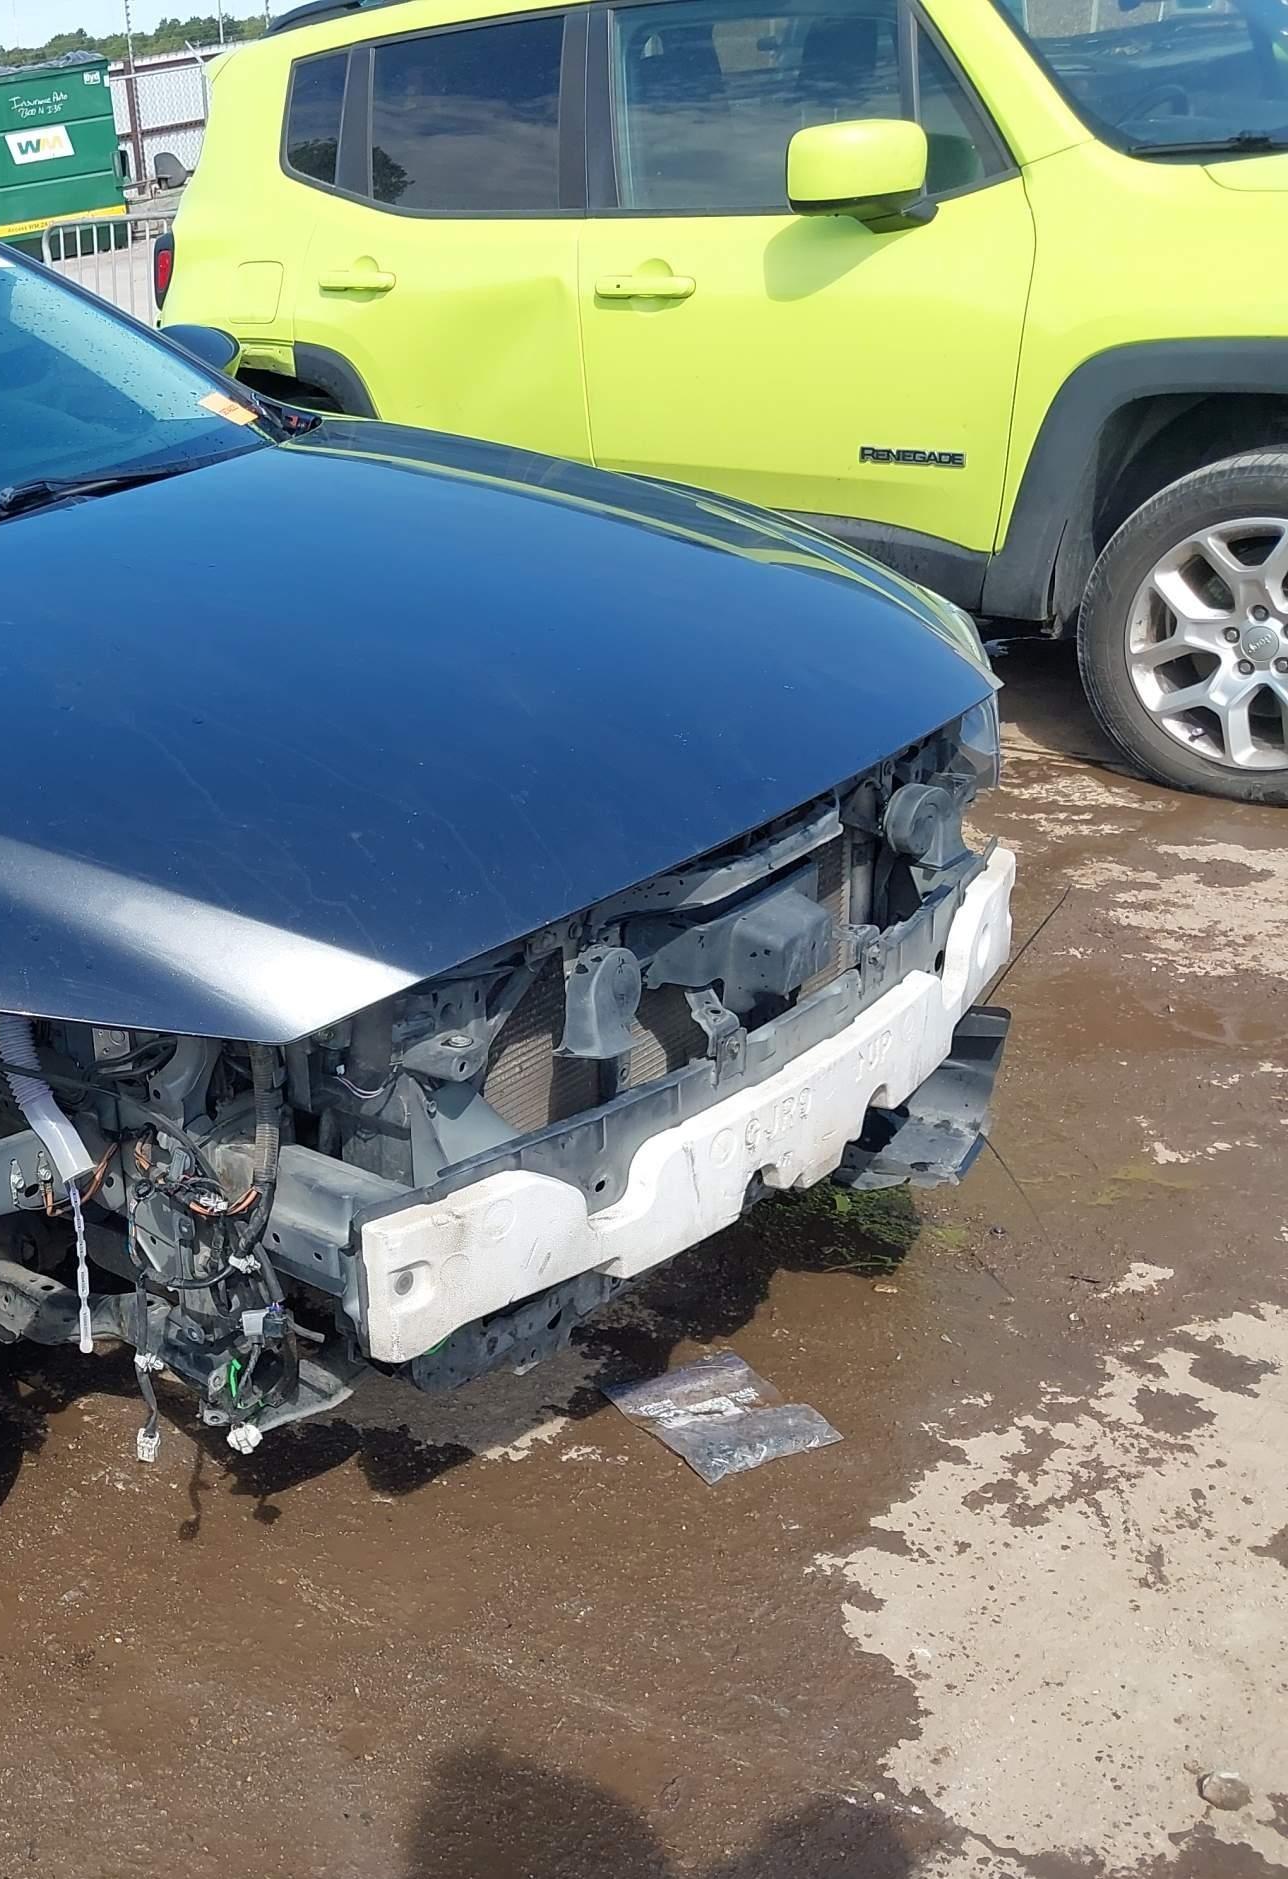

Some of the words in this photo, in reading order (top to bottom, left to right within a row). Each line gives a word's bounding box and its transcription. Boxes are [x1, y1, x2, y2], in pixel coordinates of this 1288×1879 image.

[38, 106, 45, 114] N
[17, 136, 64, 155] WM
[859, 445, 965, 468] RENEGADE
